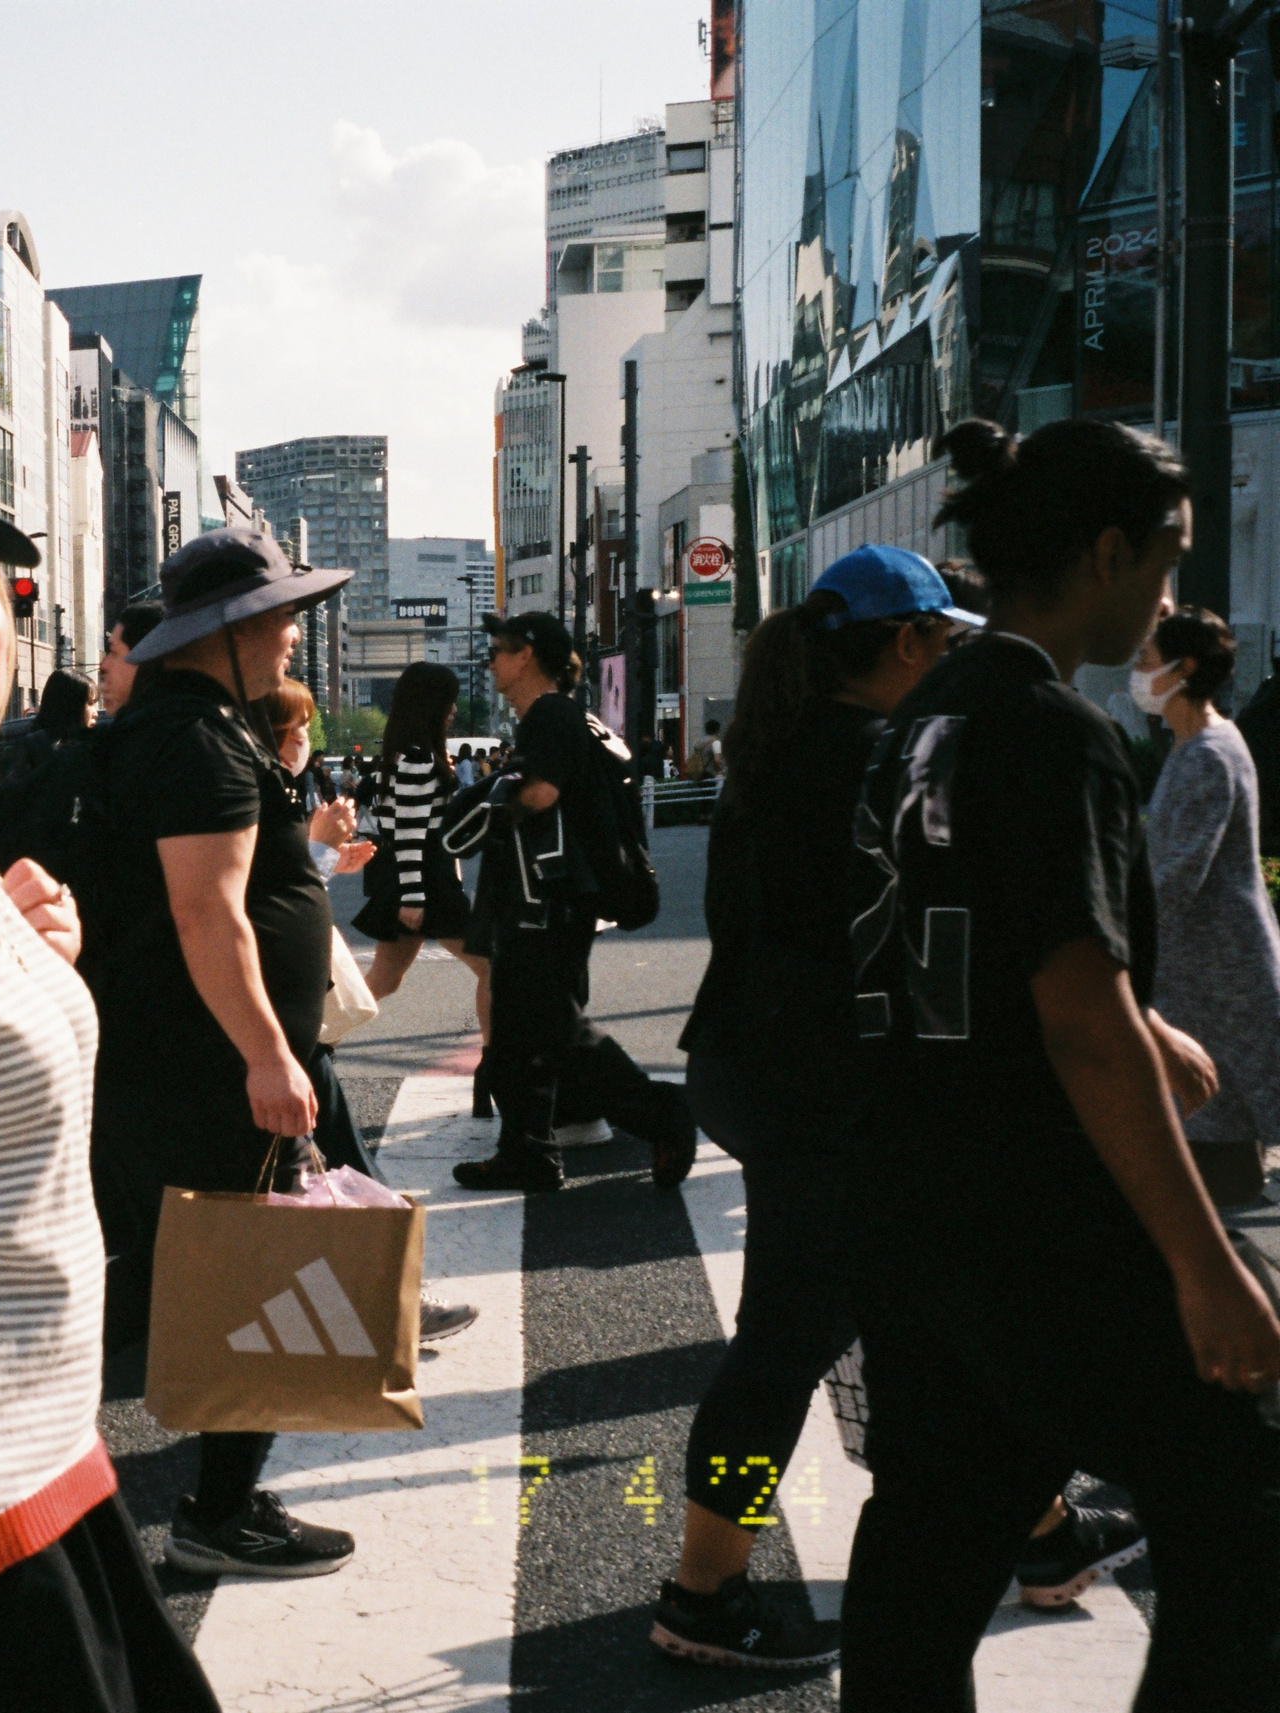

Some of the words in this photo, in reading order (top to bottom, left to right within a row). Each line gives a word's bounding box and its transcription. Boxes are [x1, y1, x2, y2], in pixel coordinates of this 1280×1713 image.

[1086, 228, 1158, 258] 2024
[1084, 257, 1106, 351] APRIL
[168, 499, 179, 522] PAL
[692, 553, 721, 567] 消火栓
